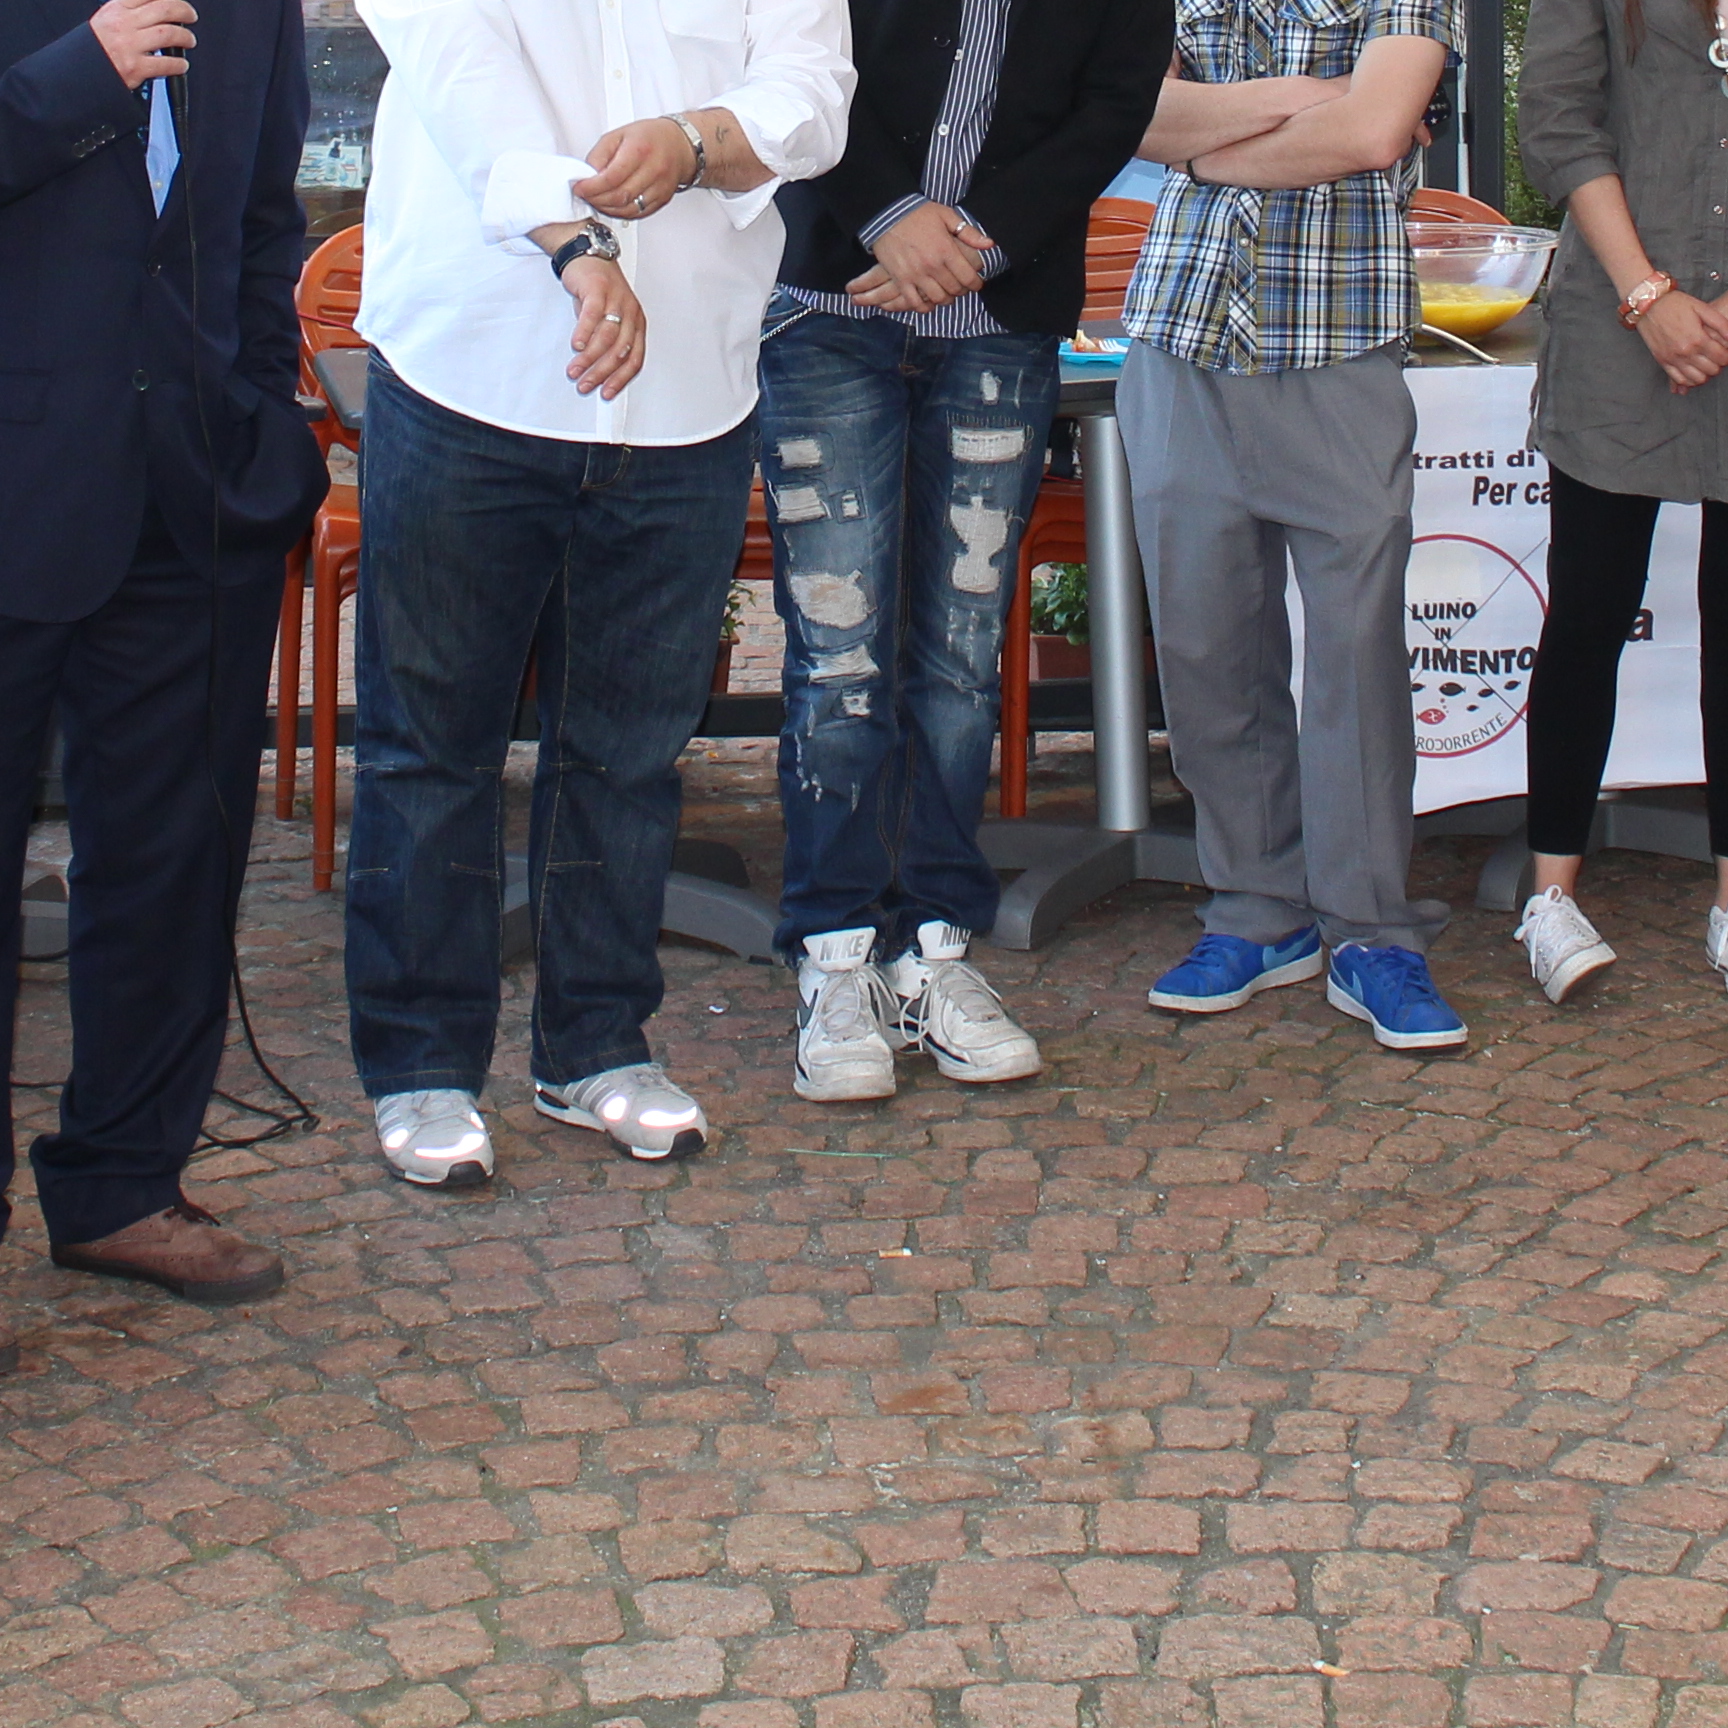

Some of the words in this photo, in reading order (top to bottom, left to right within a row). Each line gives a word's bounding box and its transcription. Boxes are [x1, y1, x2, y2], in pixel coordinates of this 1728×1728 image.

[1506, 449, 1536, 468] di
[1471, 475, 1518, 506] Per
[1411, 601, 1477, 621] LUINO
[1434, 627, 1452, 641] IN
[818, 934, 866, 962] NIKE
